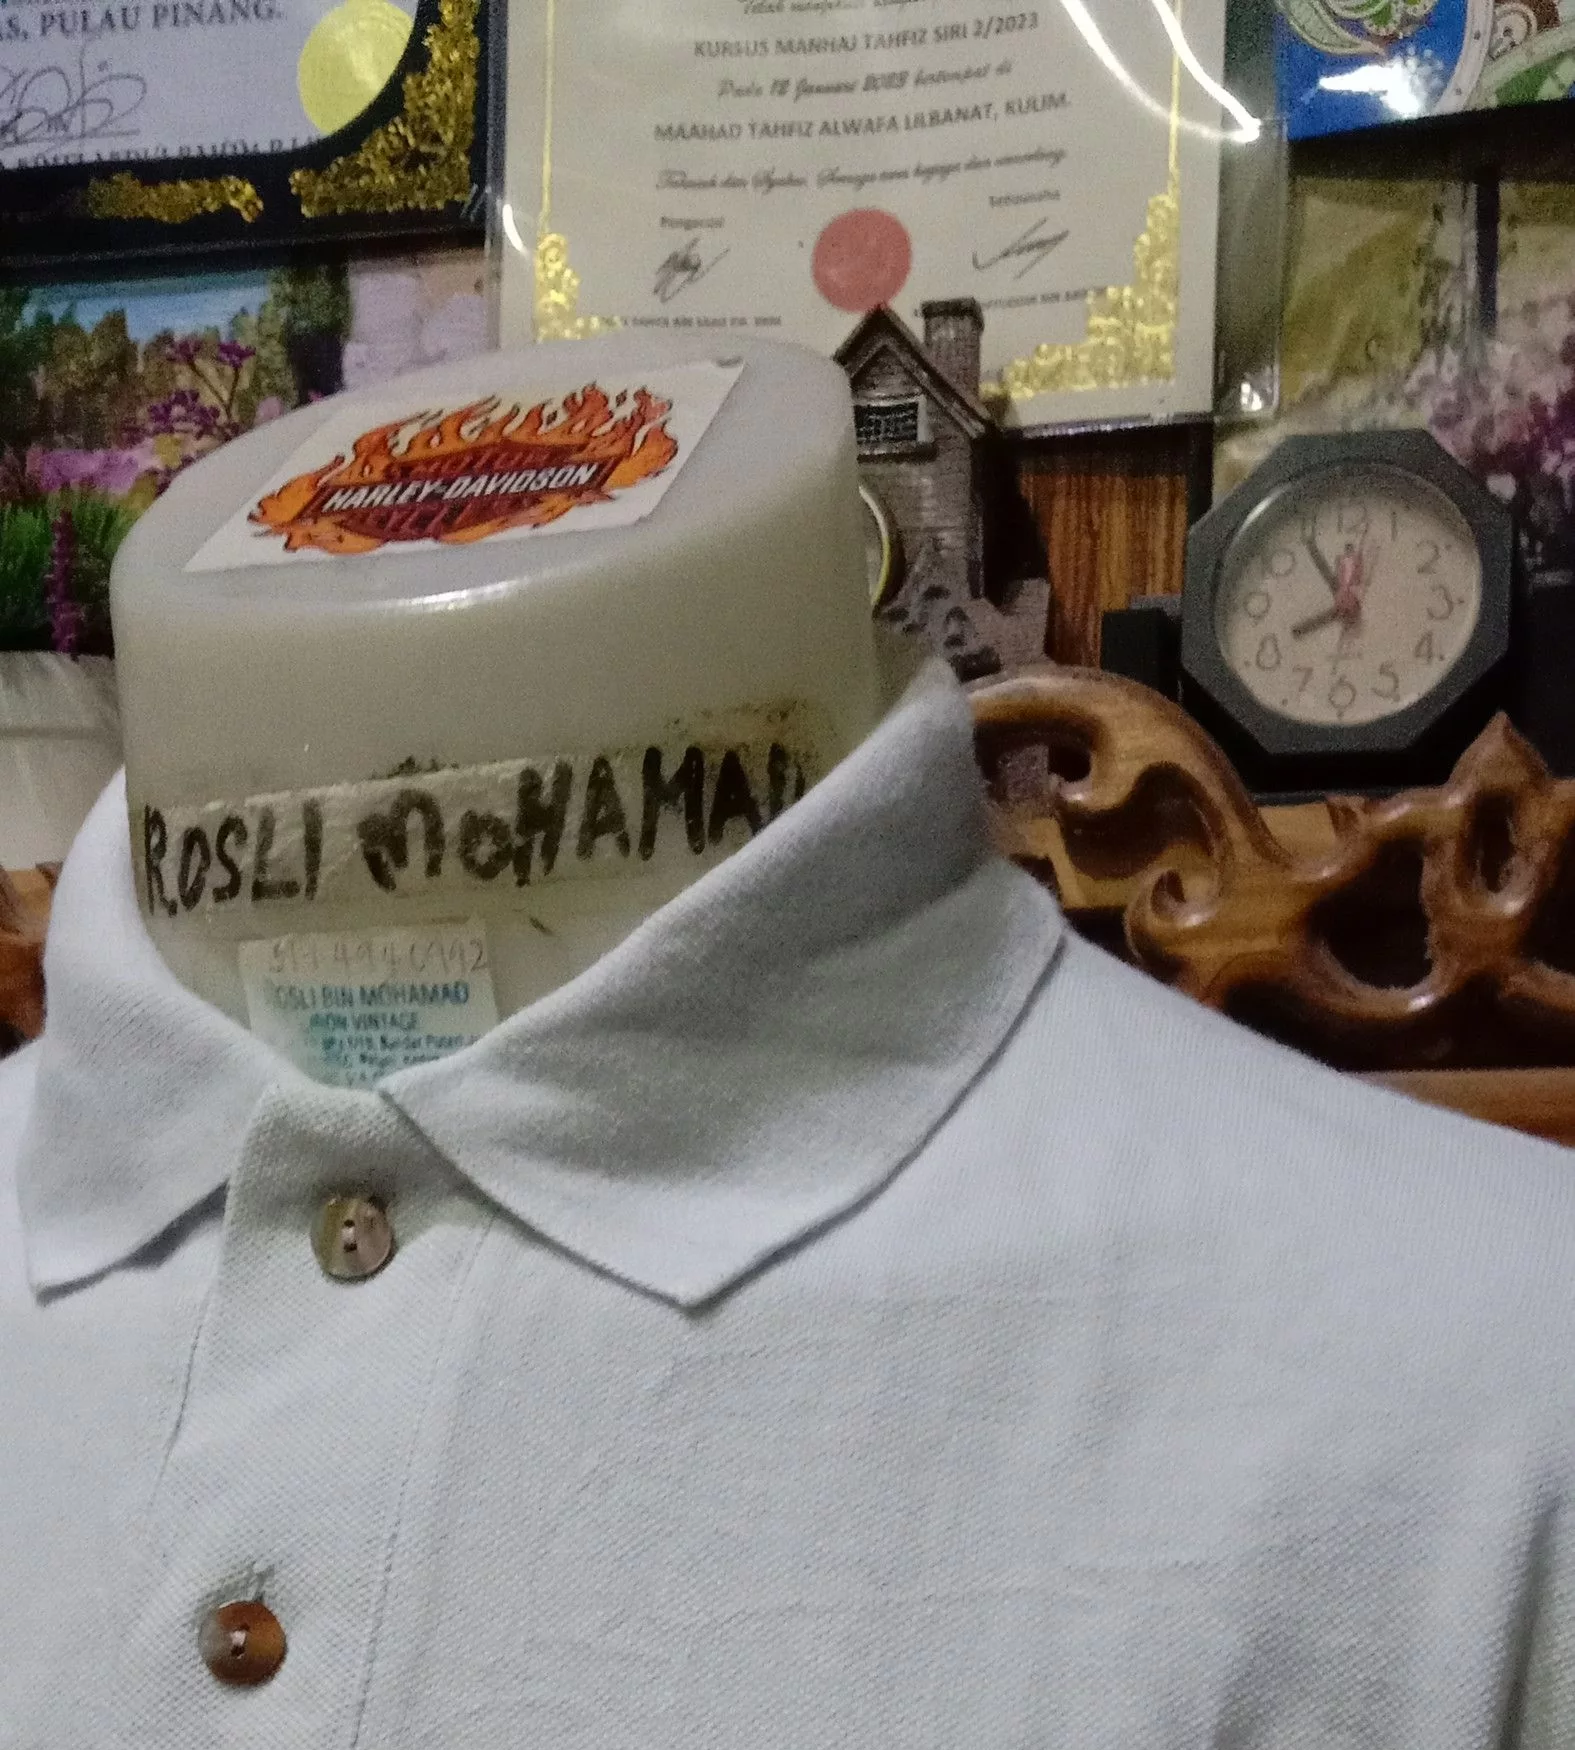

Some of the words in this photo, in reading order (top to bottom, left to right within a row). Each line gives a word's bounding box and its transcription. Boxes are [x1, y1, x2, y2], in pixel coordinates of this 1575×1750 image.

[40, 8, 139, 39] PULAU
[152, 0, 281, 29] PINANG.
[694, 39, 769, 58] KURSUS
[775, 34, 858, 56] MANHAJ
[864, 28, 927, 50] TAHFIZ
[933, 24, 967, 44] SIRI
[972, 12, 1039, 38] 2/2023
[653, 122, 742, 141] MAAHAD
[749, 119, 812, 139] TAHFIZ
[818, 115, 898, 137] ALWAFA
[321, 462, 599, 513] HARLEY-DAVIDSON
[1415, 540, 1440, 575] 2
[1426, 584, 1456, 621] 3
[1291, 666, 1314, 693] 7
[1371, 661, 1400, 700] 5
[143, 800, 322, 917] ROSLI
